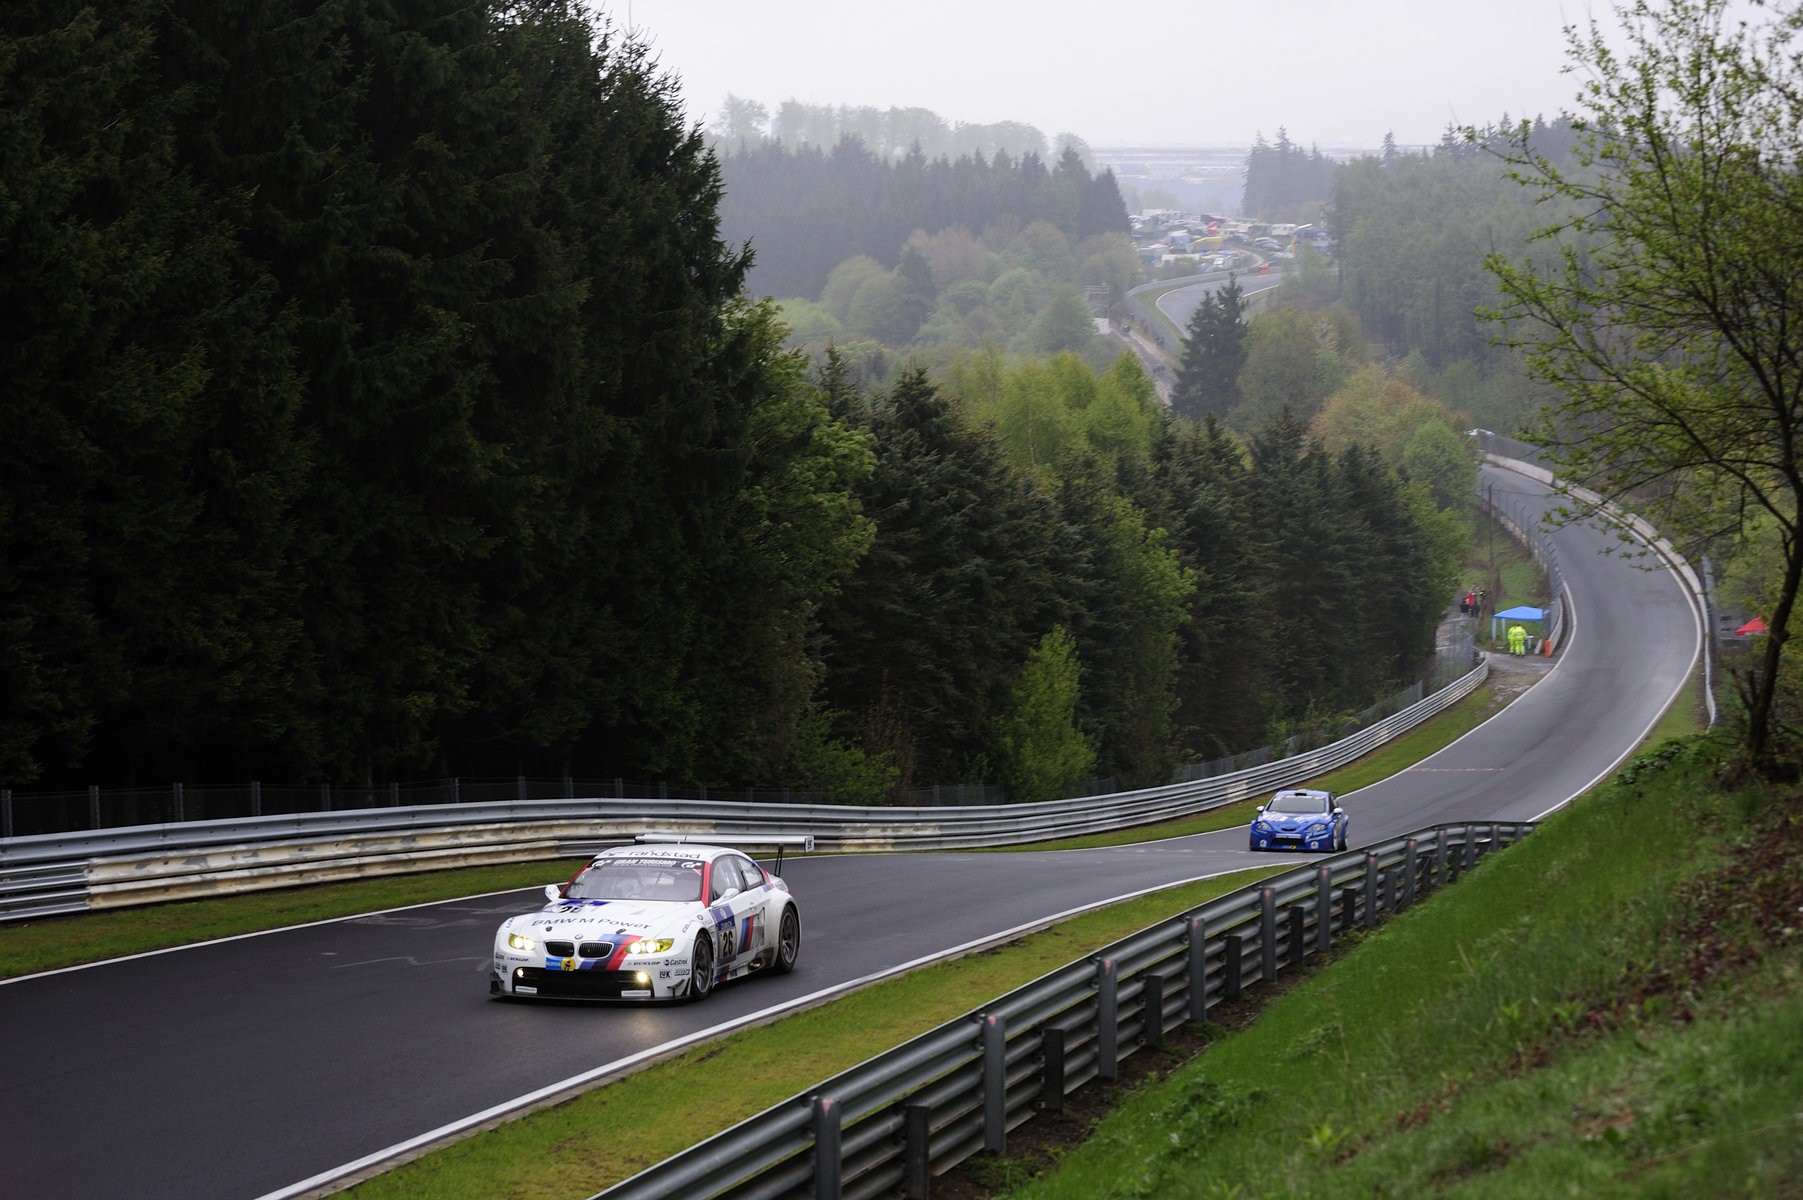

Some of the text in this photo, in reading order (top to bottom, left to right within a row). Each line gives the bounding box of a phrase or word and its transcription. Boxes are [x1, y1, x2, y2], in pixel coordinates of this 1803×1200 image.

[628, 850, 701, 859] randstad
[531, 918, 577, 926] BMW
[598, 918, 653, 929] Power
[722, 930, 733, 957] 26
[669, 958, 688, 966] Castrol
